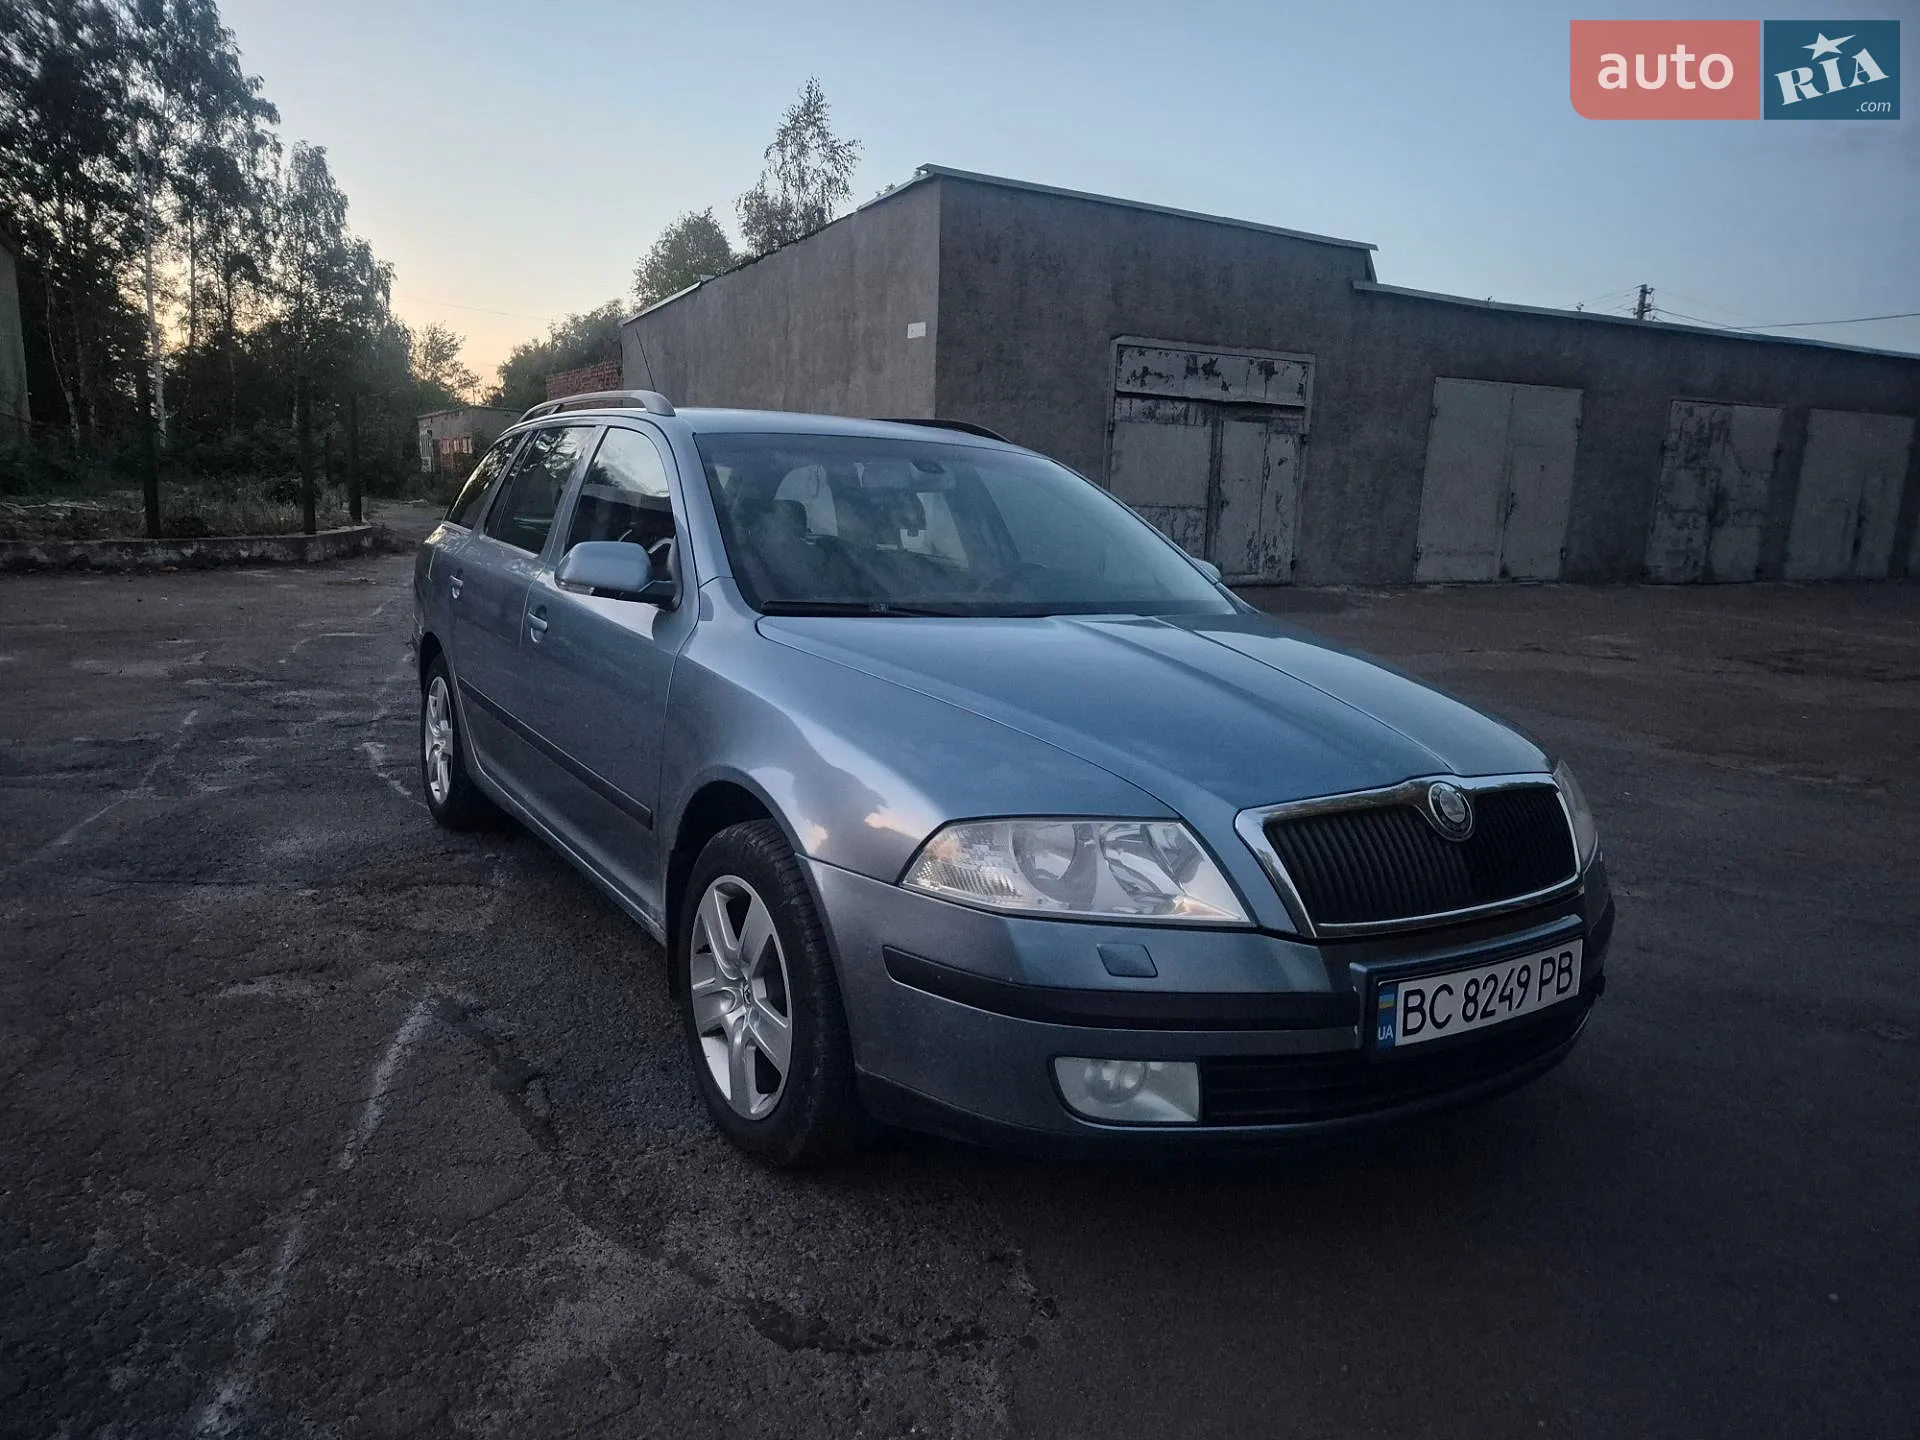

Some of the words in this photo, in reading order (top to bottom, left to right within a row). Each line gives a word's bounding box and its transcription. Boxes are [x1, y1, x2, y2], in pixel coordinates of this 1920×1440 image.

[1402, 983, 1454, 1037] BC
[1461, 965, 1531, 1023] 8249
[1537, 951, 1573, 1001] PB
[1377, 1026, 1394, 1041] UA
